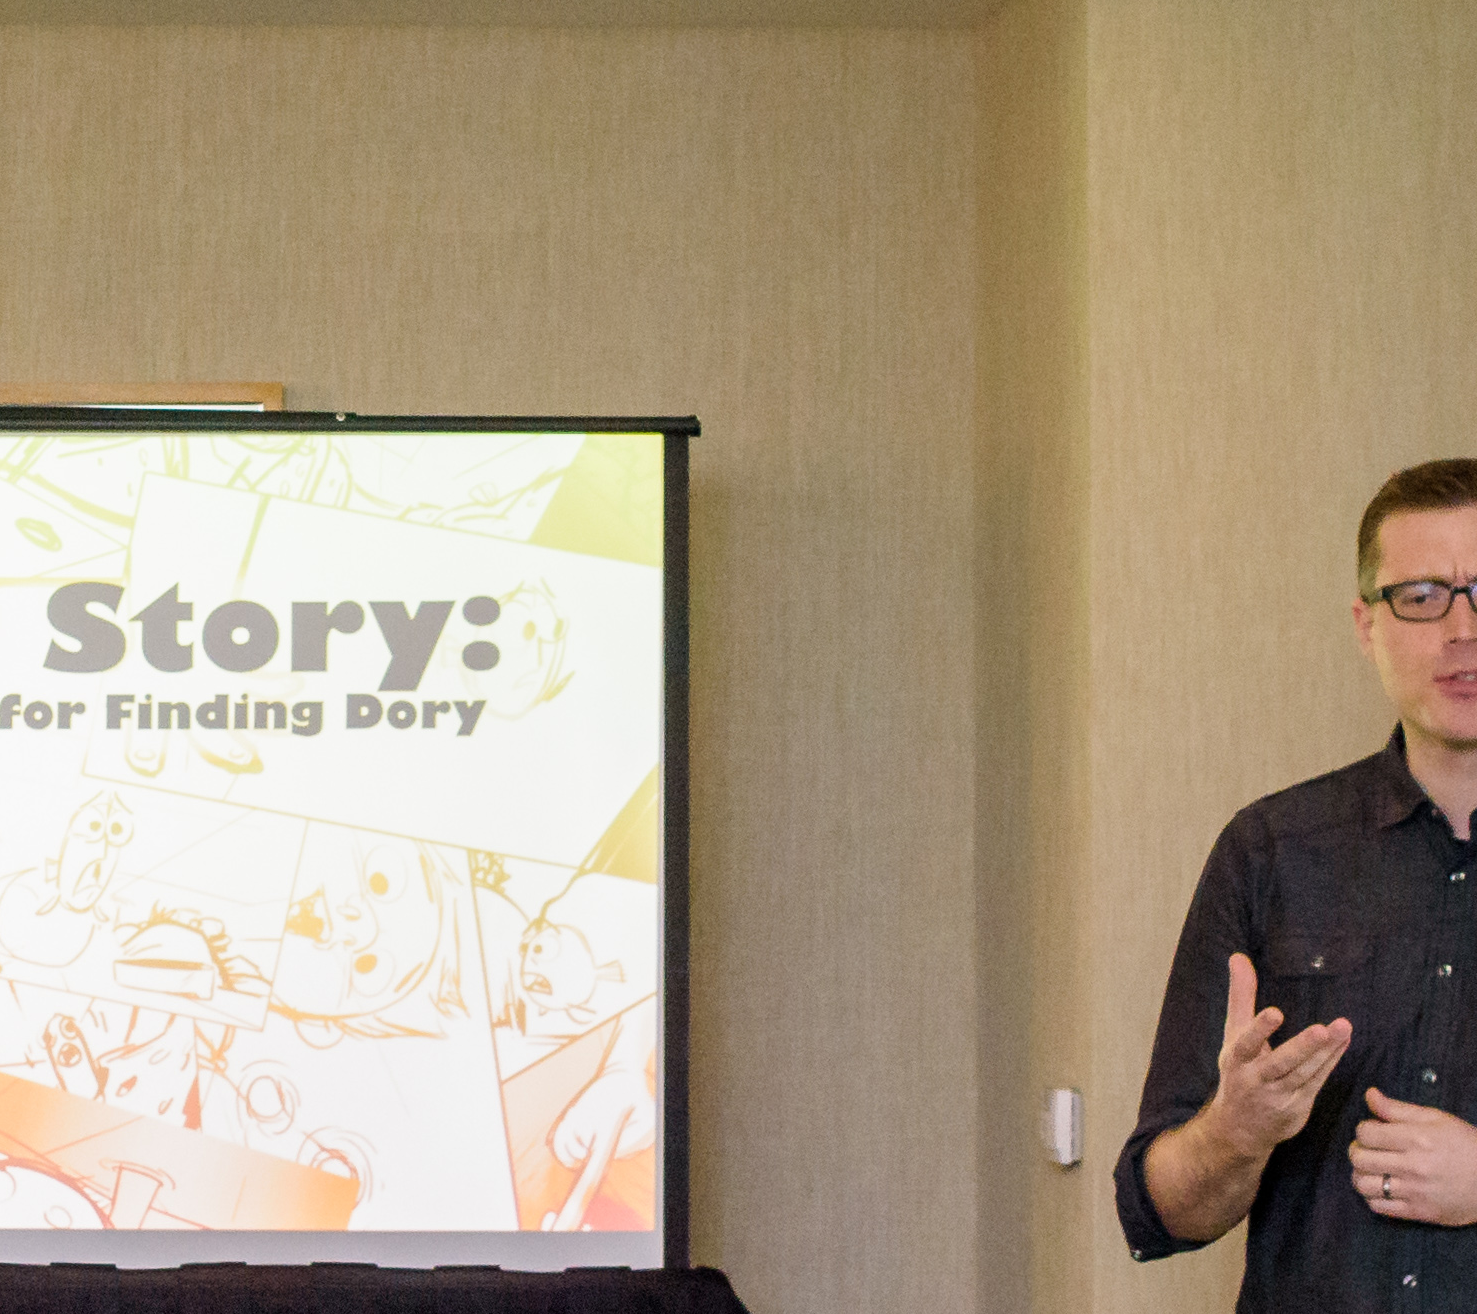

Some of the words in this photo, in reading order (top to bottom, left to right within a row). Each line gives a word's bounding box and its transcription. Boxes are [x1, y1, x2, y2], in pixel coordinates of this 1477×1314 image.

[44, 581, 501, 692] Story:
[106, 694, 324, 737] Finding
[345, 694, 486, 736] Dory
